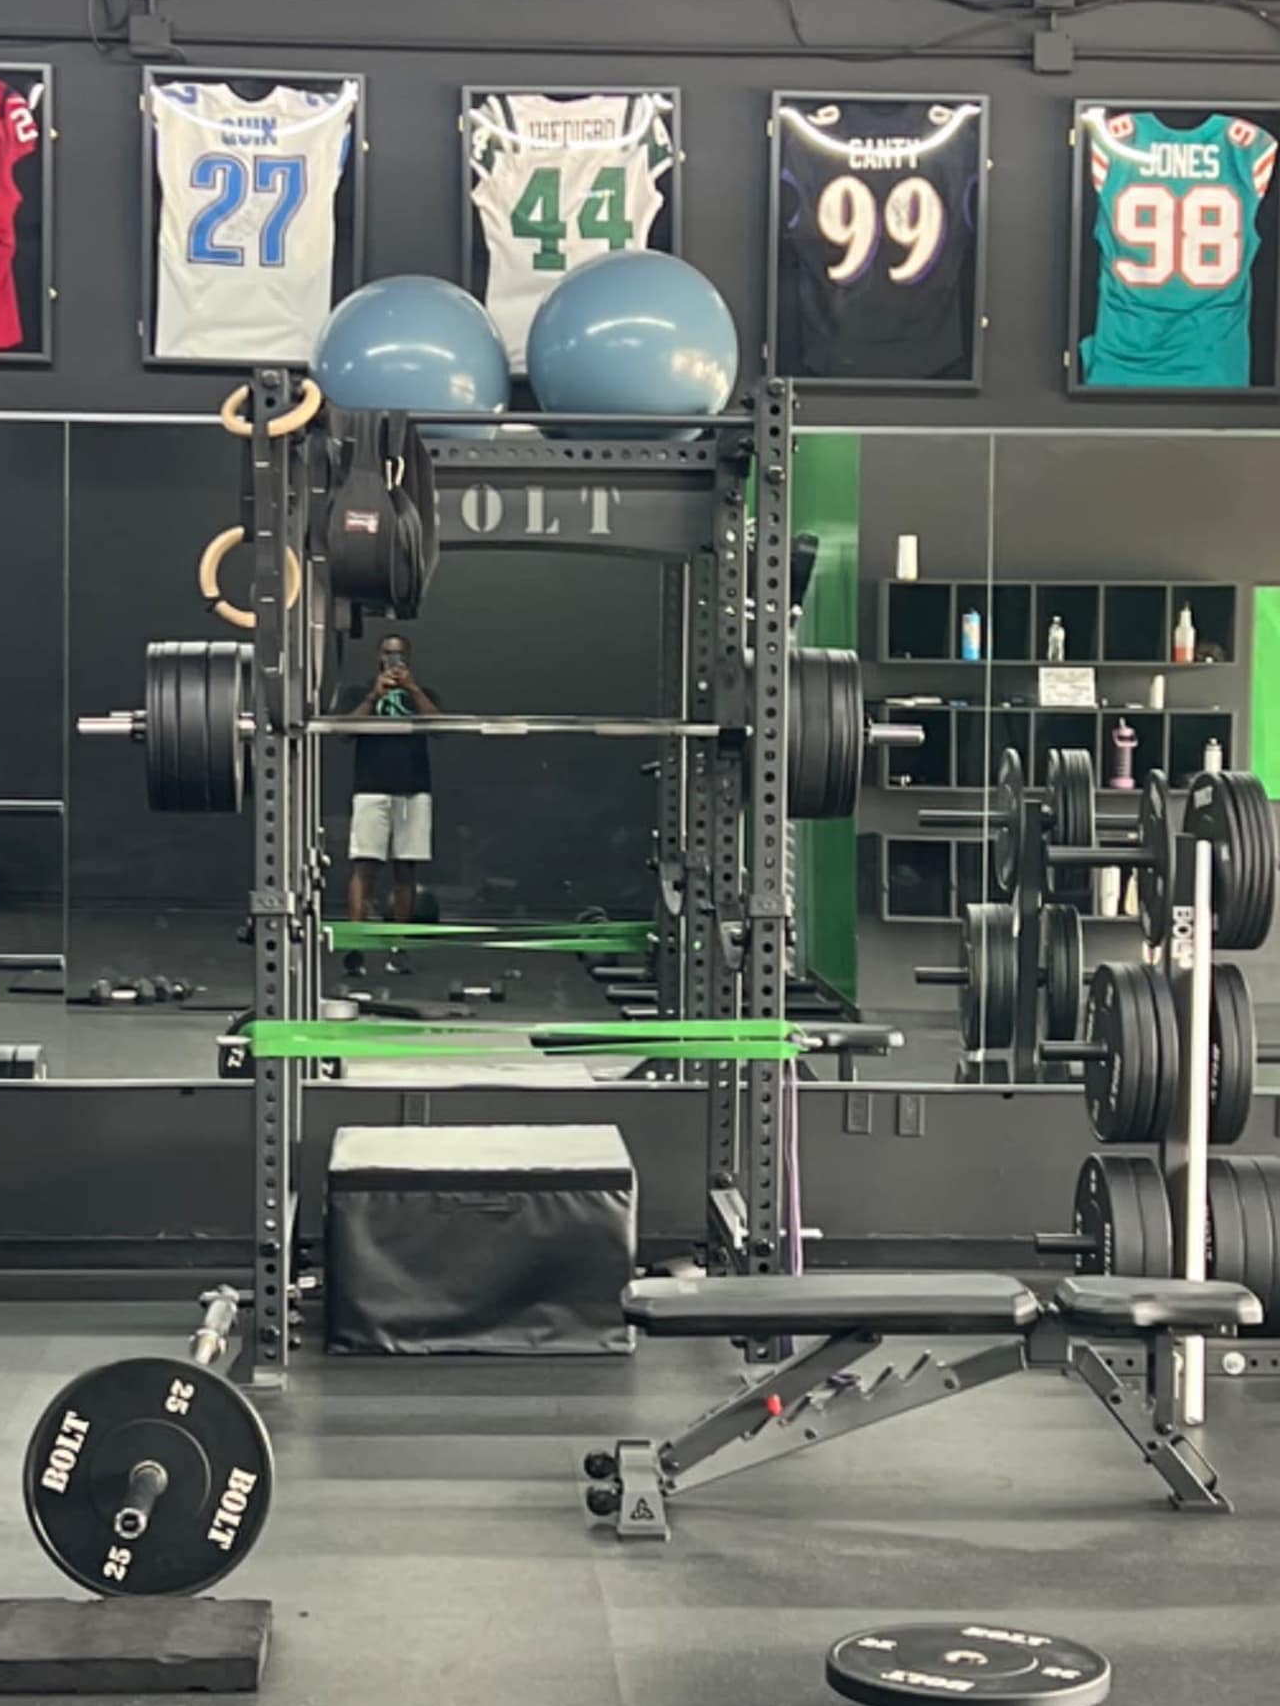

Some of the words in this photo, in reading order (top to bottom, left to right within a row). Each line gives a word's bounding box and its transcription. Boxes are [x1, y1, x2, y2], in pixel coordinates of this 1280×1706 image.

[220, 116, 278, 146] QUIN
[848, 137, 921, 170] CANTY
[1140, 140, 1221, 180] JONES
[186, 154, 310, 269] 27
[510, 166, 635, 272] 44
[817, 174, 944, 285] 99
[1115, 183, 1244, 288] 98
[461, 483, 621, 536] OLT
[164, 1378, 196, 1416] 25
[41, 1410, 91, 1494] BOLT
[207, 1466, 258, 1551] BOLT
[103, 1545, 133, 1582] 25
